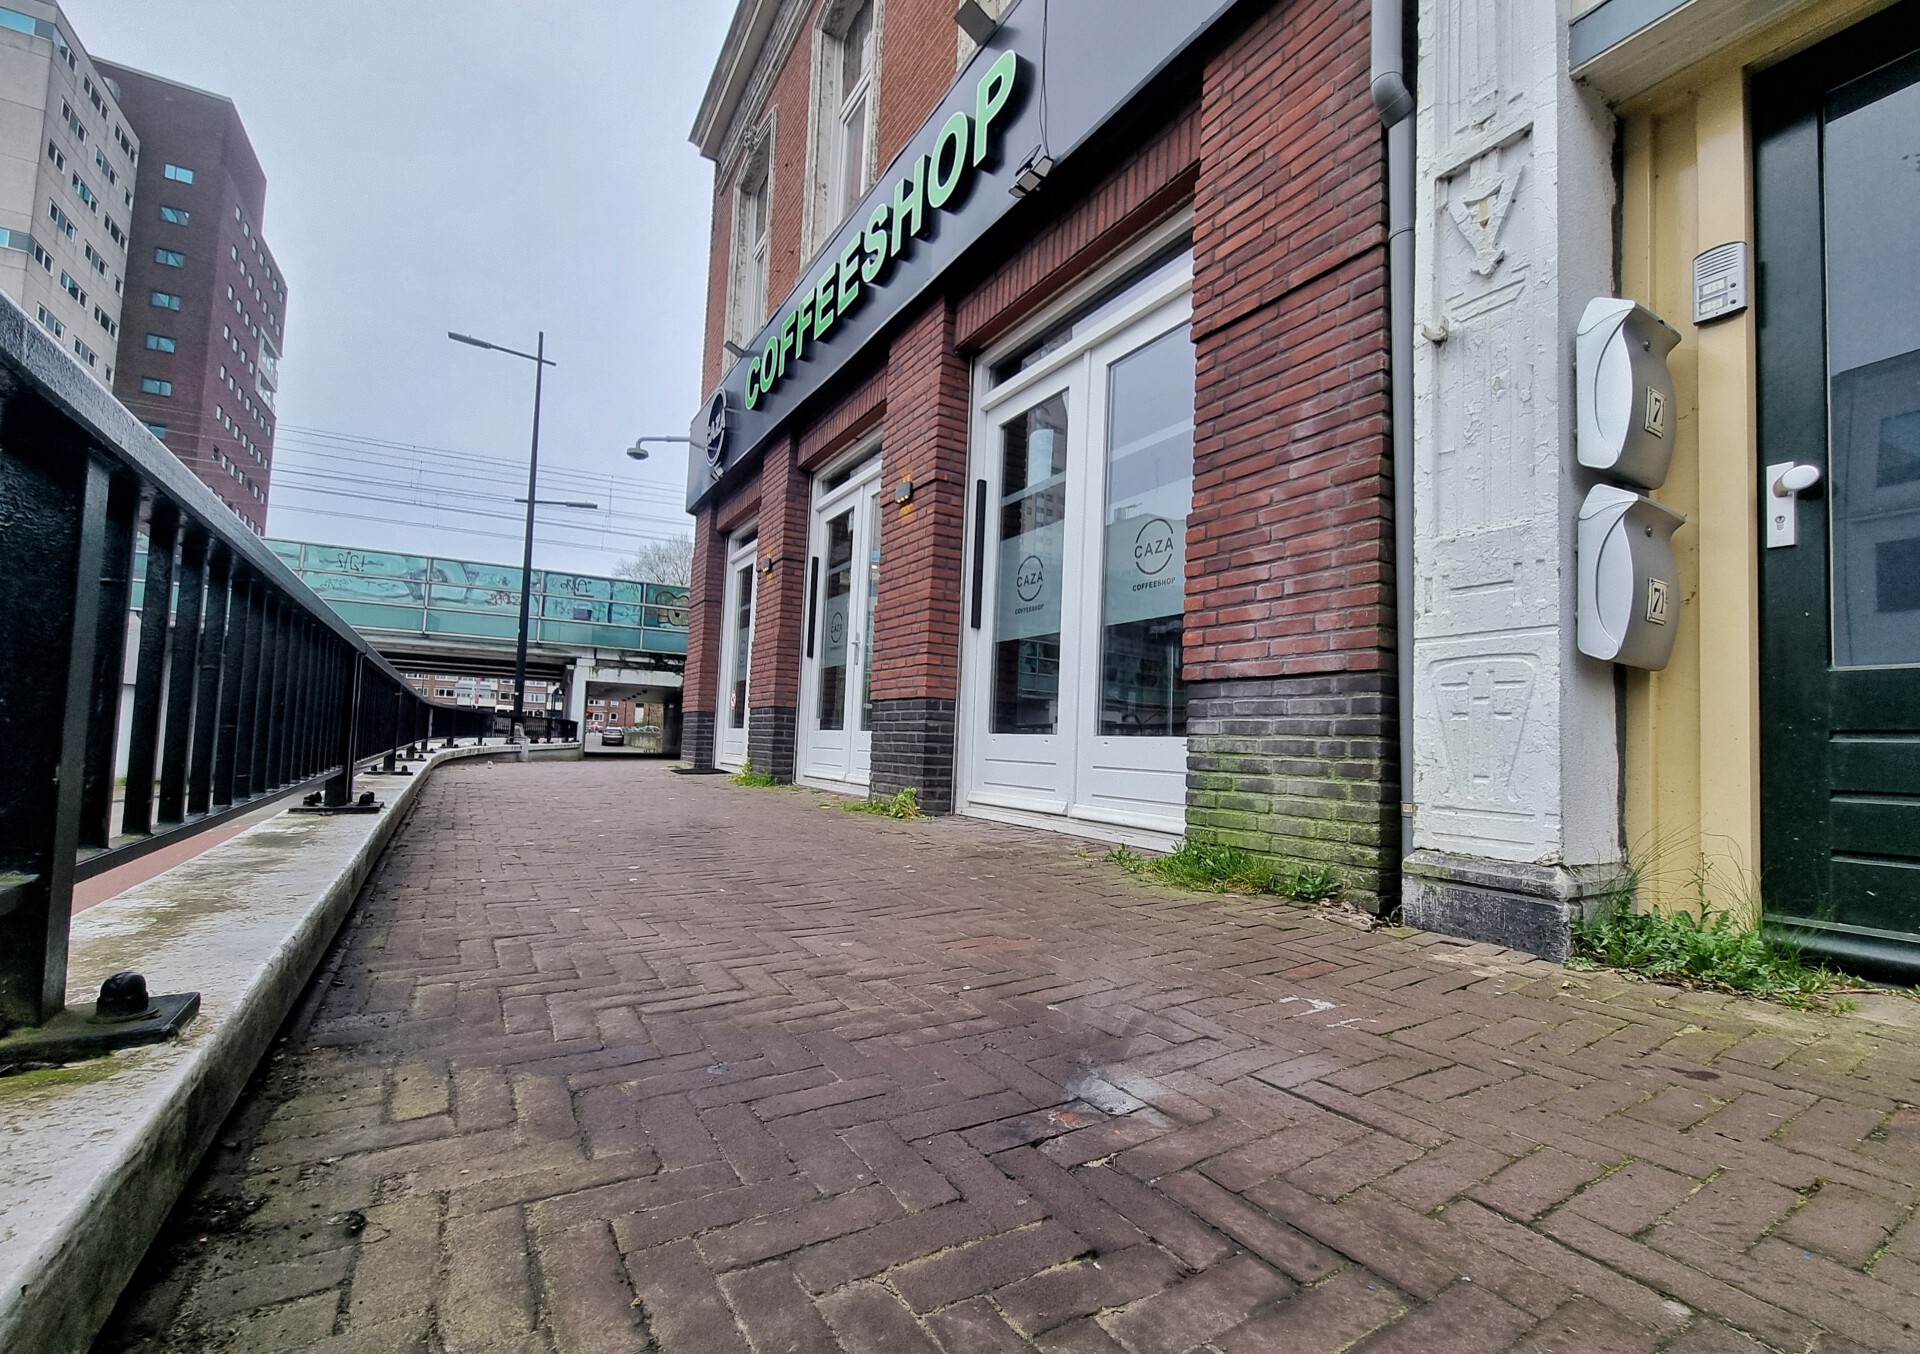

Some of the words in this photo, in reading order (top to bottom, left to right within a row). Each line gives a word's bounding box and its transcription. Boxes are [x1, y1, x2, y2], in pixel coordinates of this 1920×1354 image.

[744, 49, 1016, 410] COFFEESHOP
[705, 408, 726, 446] CAZA
[1134, 536, 1174, 559] CAZA
[1016, 570, 1044, 588] CAZA
[1132, 577, 1176, 592] COFFEESHOP
[1014, 603, 1045, 615] COFFEESHOP
